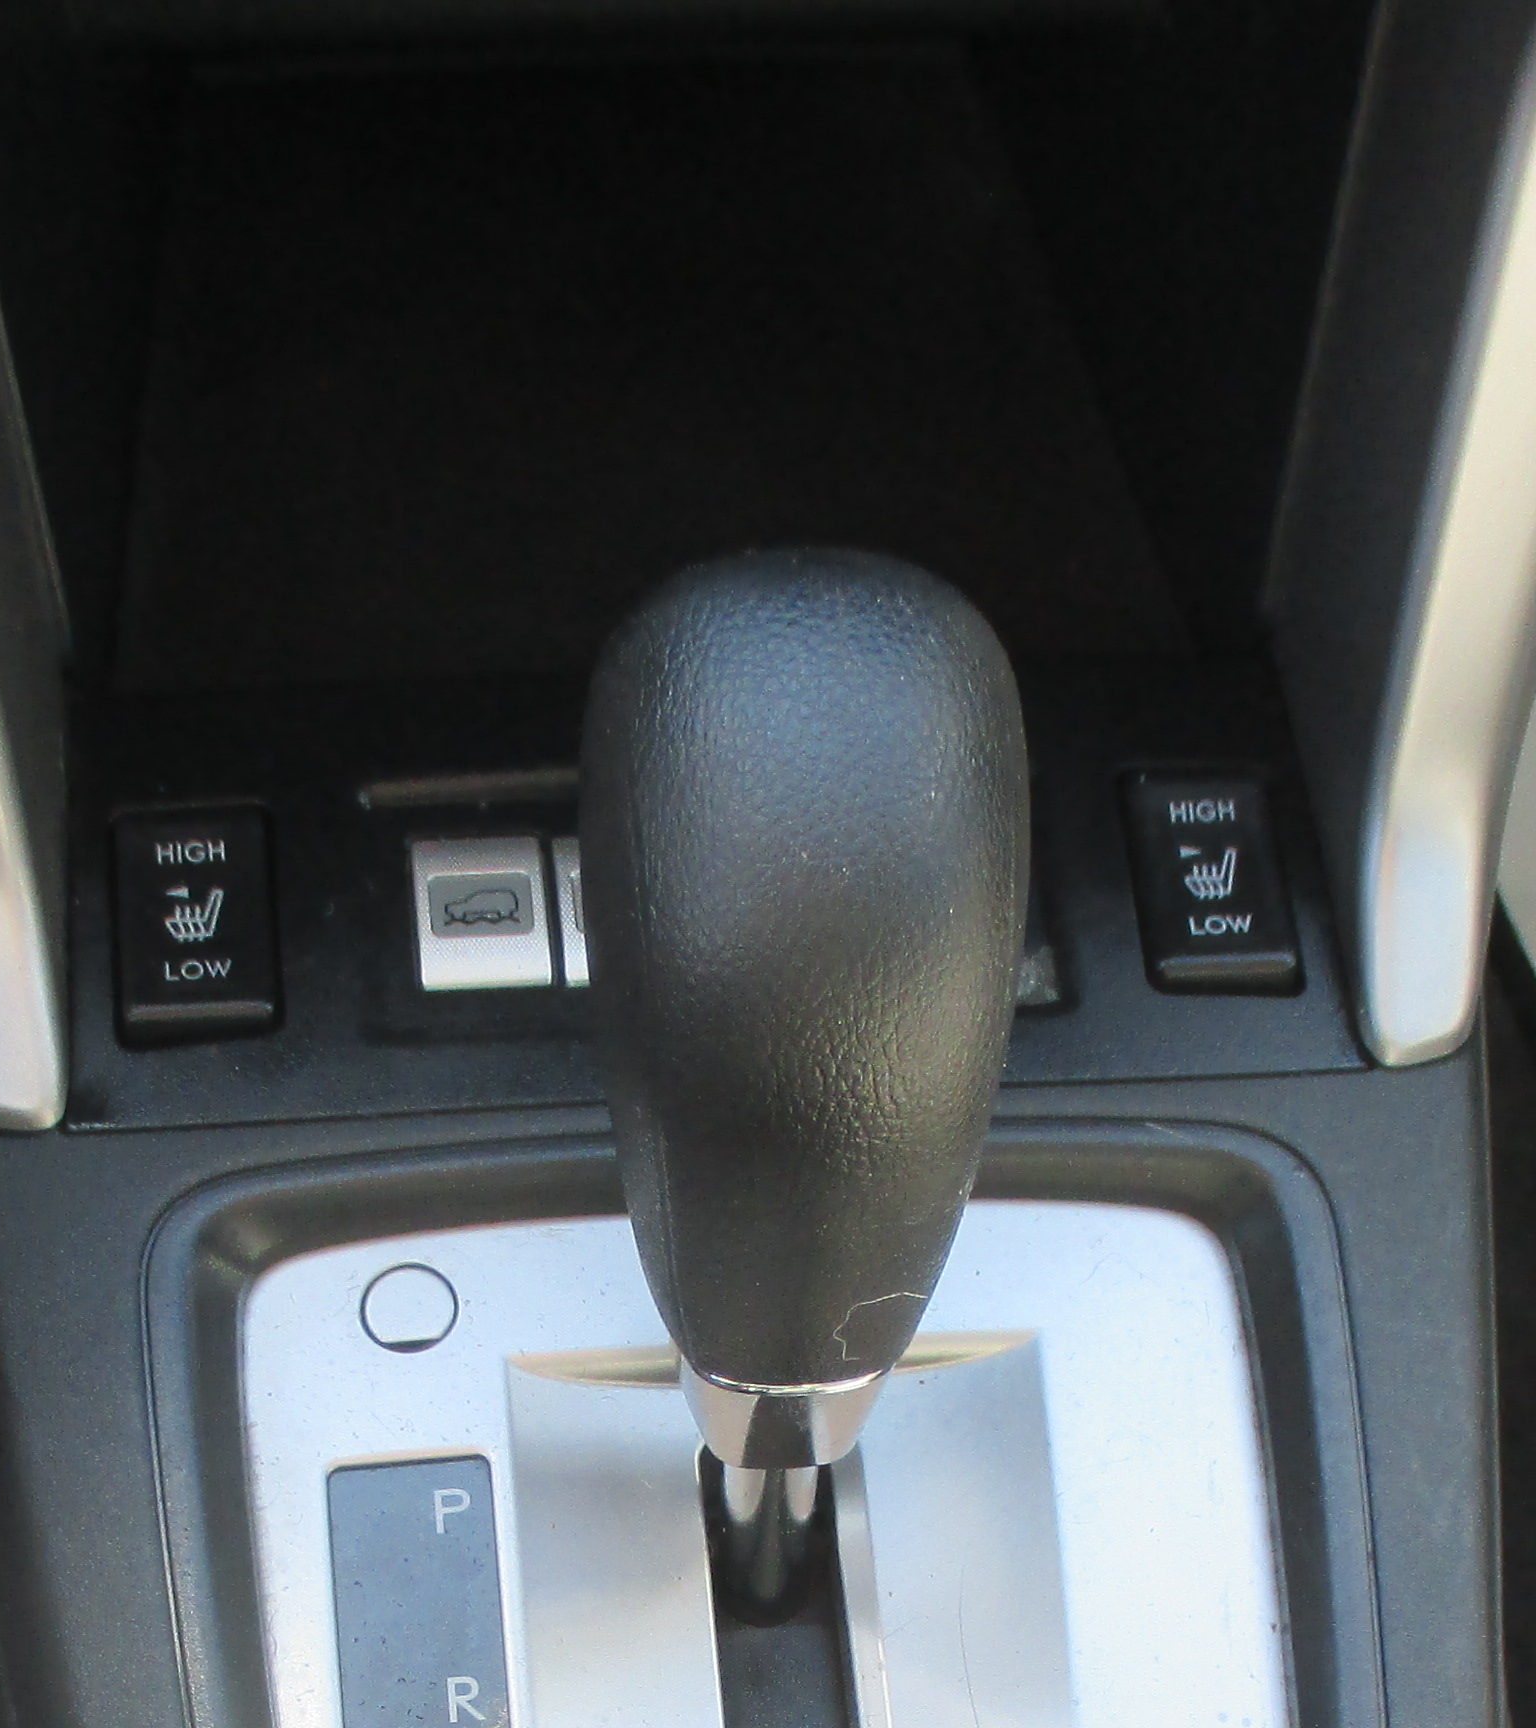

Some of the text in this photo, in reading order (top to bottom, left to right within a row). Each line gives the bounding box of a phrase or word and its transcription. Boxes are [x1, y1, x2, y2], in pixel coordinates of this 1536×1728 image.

[1169, 799, 1236, 824] HIGH
[155, 839, 226, 865] HIGH
[1189, 913, 1252, 936] LOW
[165, 958, 232, 981] LOW
[432, 1488, 471, 1534] P
[446, 1676, 485, 1723] R
